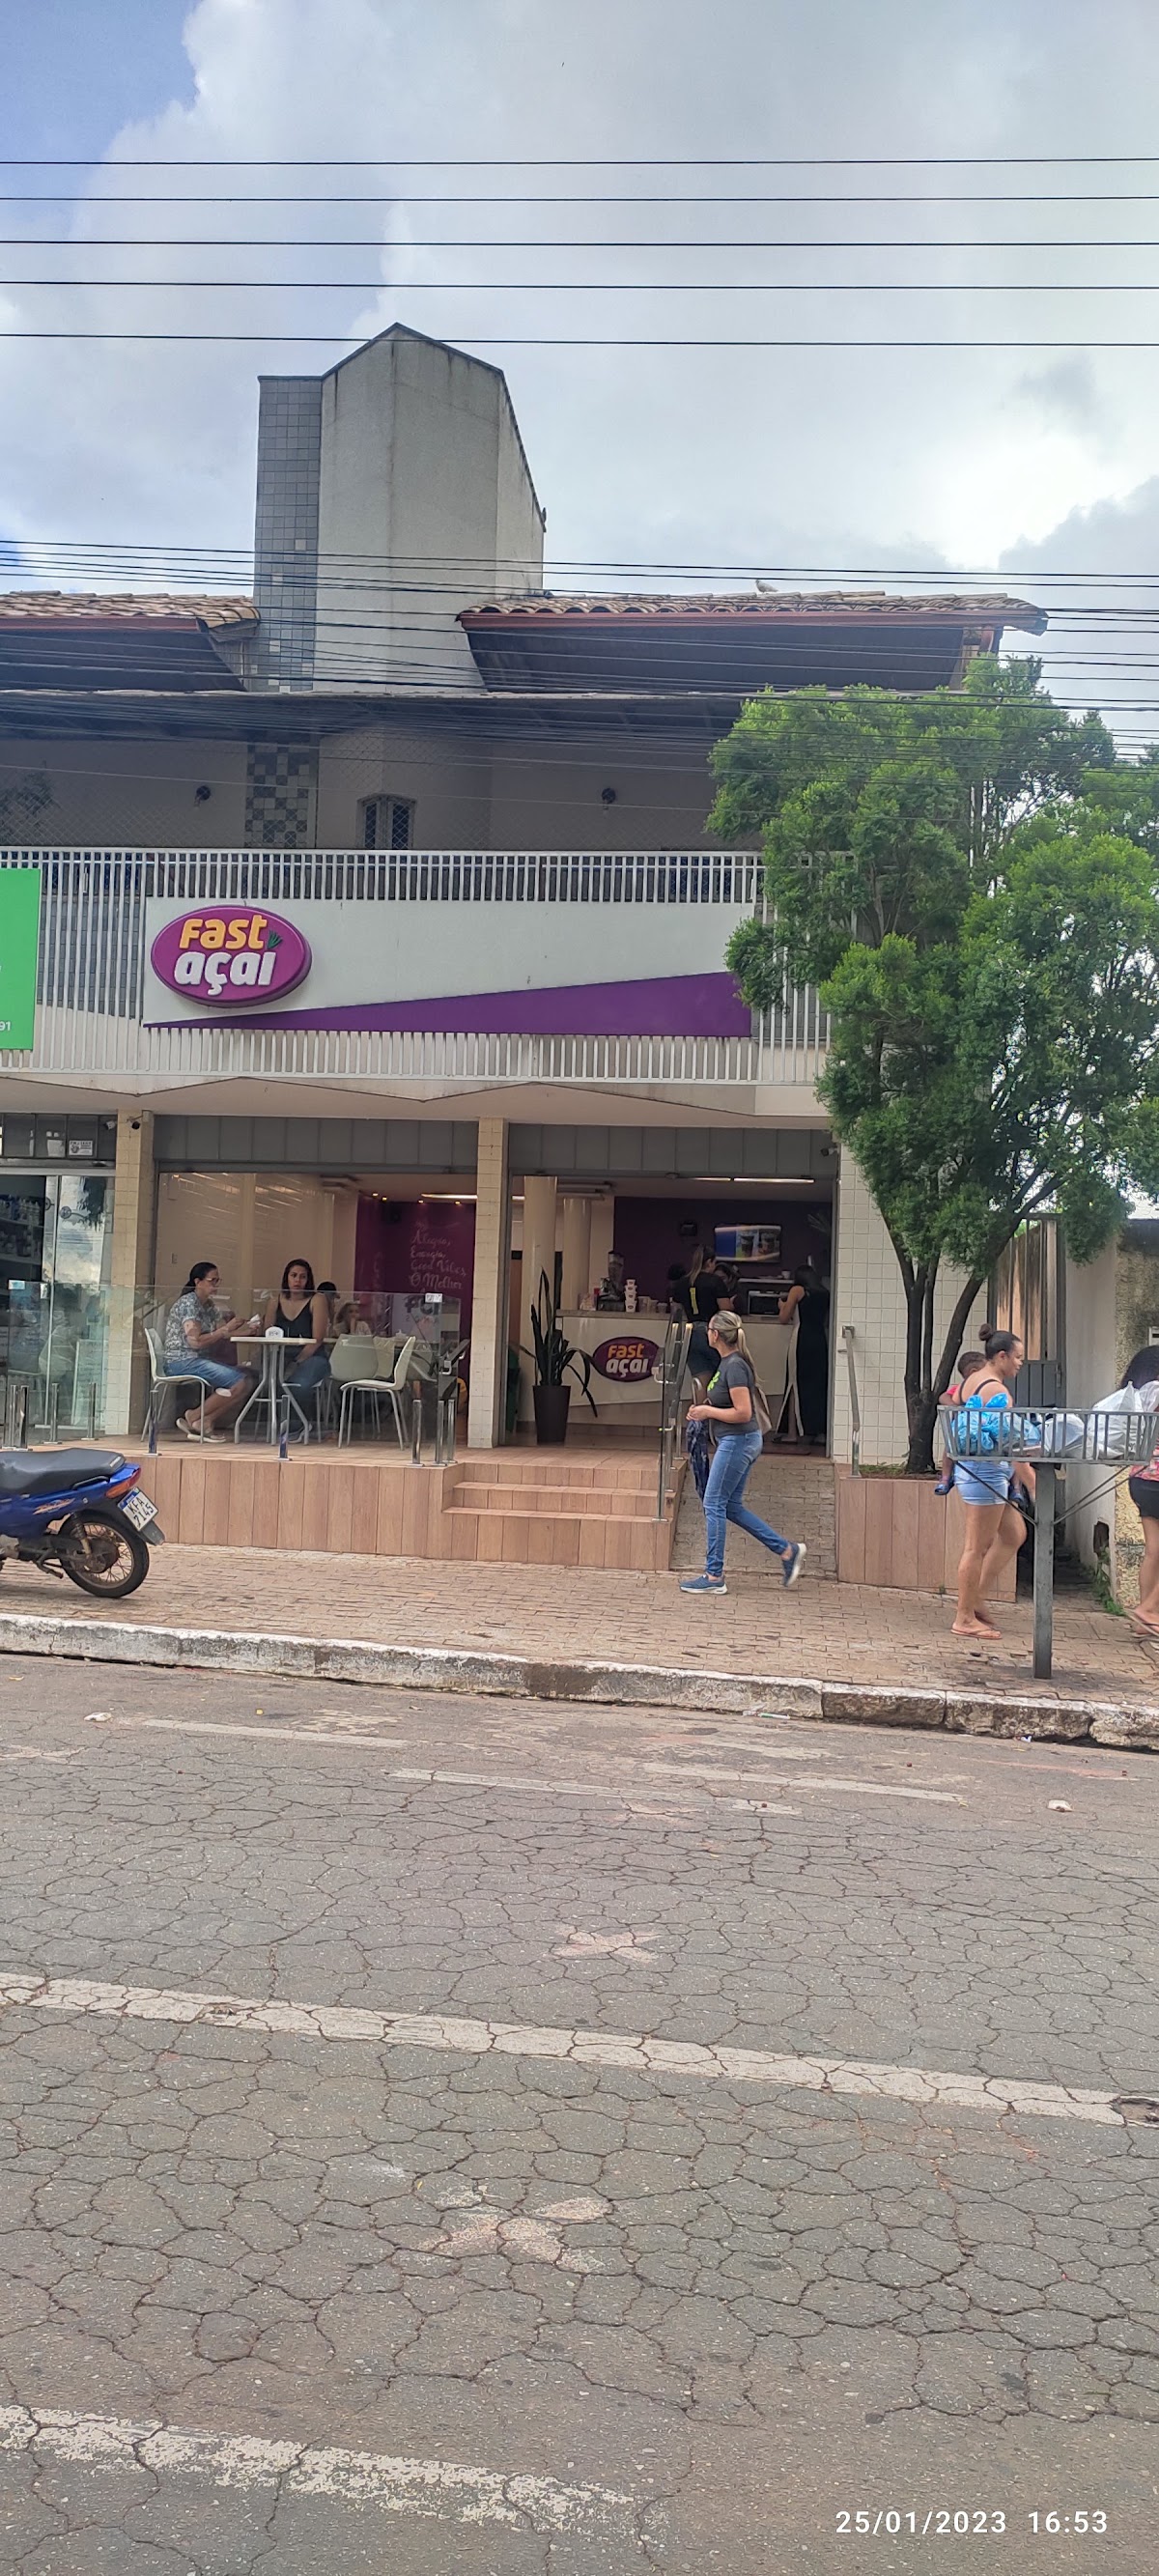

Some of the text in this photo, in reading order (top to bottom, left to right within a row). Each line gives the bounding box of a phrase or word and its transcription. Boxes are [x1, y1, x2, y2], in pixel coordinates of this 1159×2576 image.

[179, 915, 268, 949] Fast
[608, 1344, 644, 1358] Fast
[127, 1497, 145, 1514] KFA
